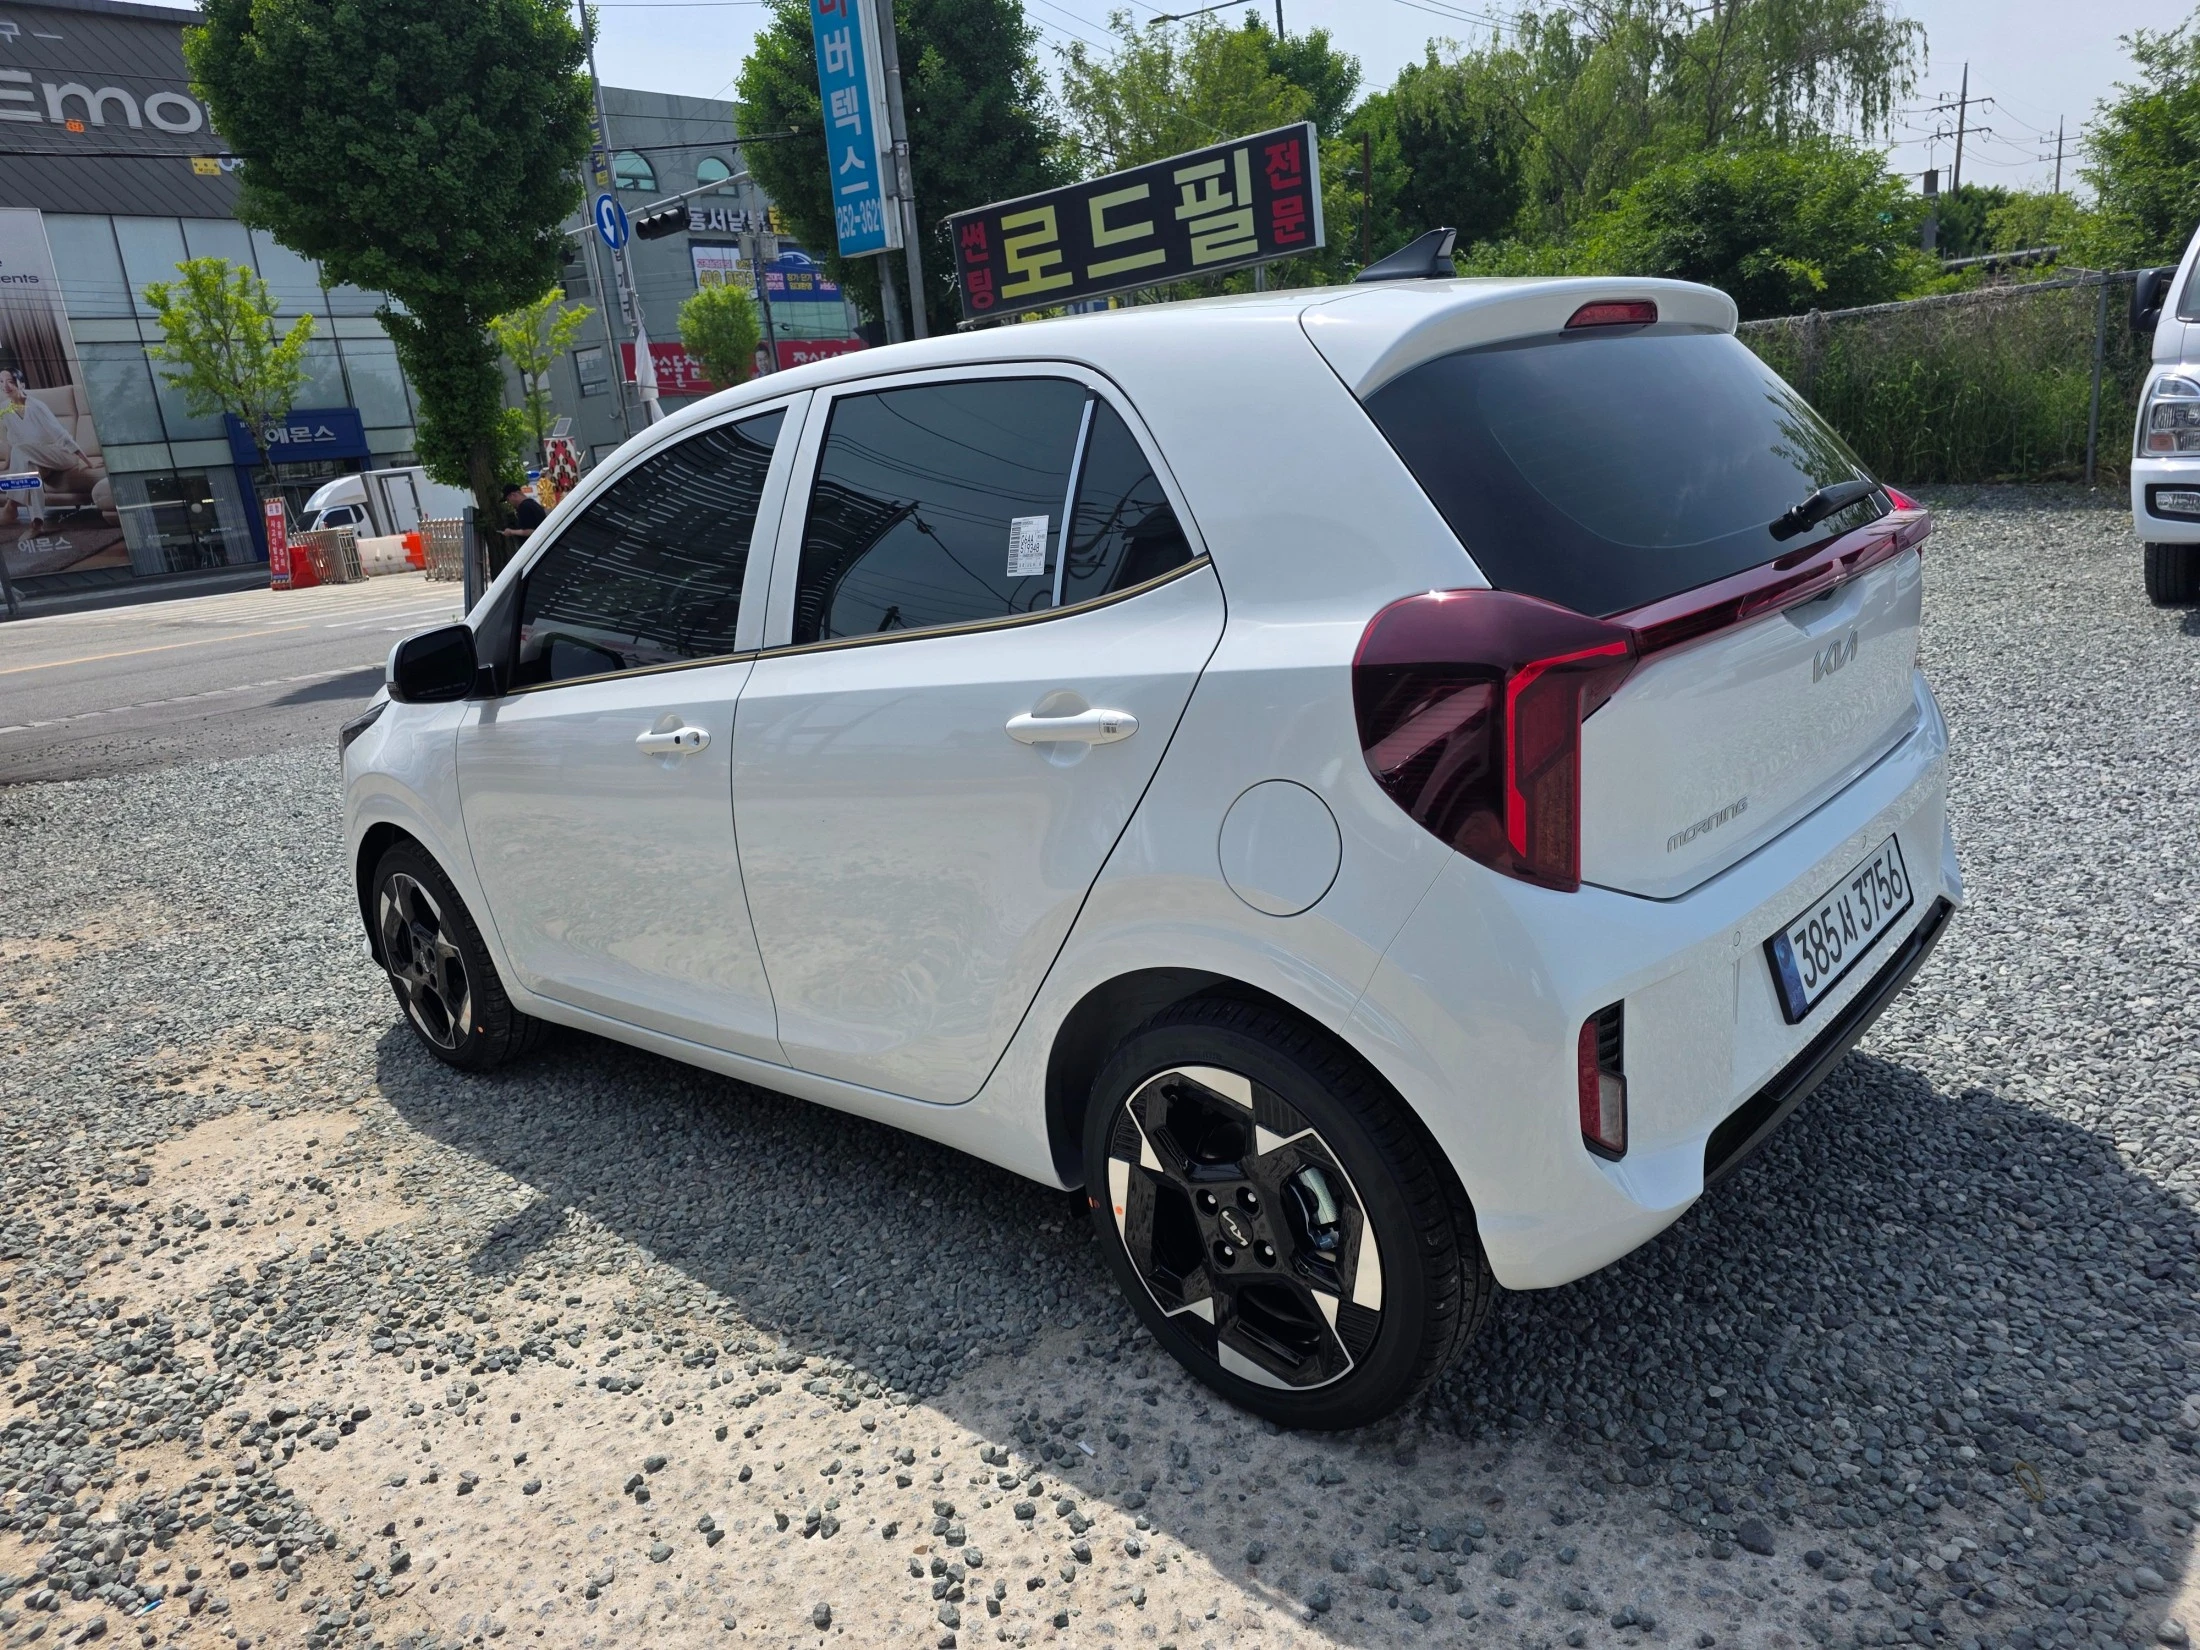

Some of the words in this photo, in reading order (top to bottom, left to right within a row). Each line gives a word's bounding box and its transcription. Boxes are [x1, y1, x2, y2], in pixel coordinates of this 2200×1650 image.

[0, 70, 219, 135] Emo
[837, 197, 884, 239] 252-3621
[1265, 140, 1306, 244] 전문
[1001, 148, 1258, 299] 로드필
[0, 274, 39, 283] ents
[961, 221, 994, 309] 썬팅
[264, 425, 337, 444] 에몬스
[18, 536, 73, 553] 에몬스
[1812, 629, 1858, 684] KIA
[1667, 796, 1748, 853] MORNING
